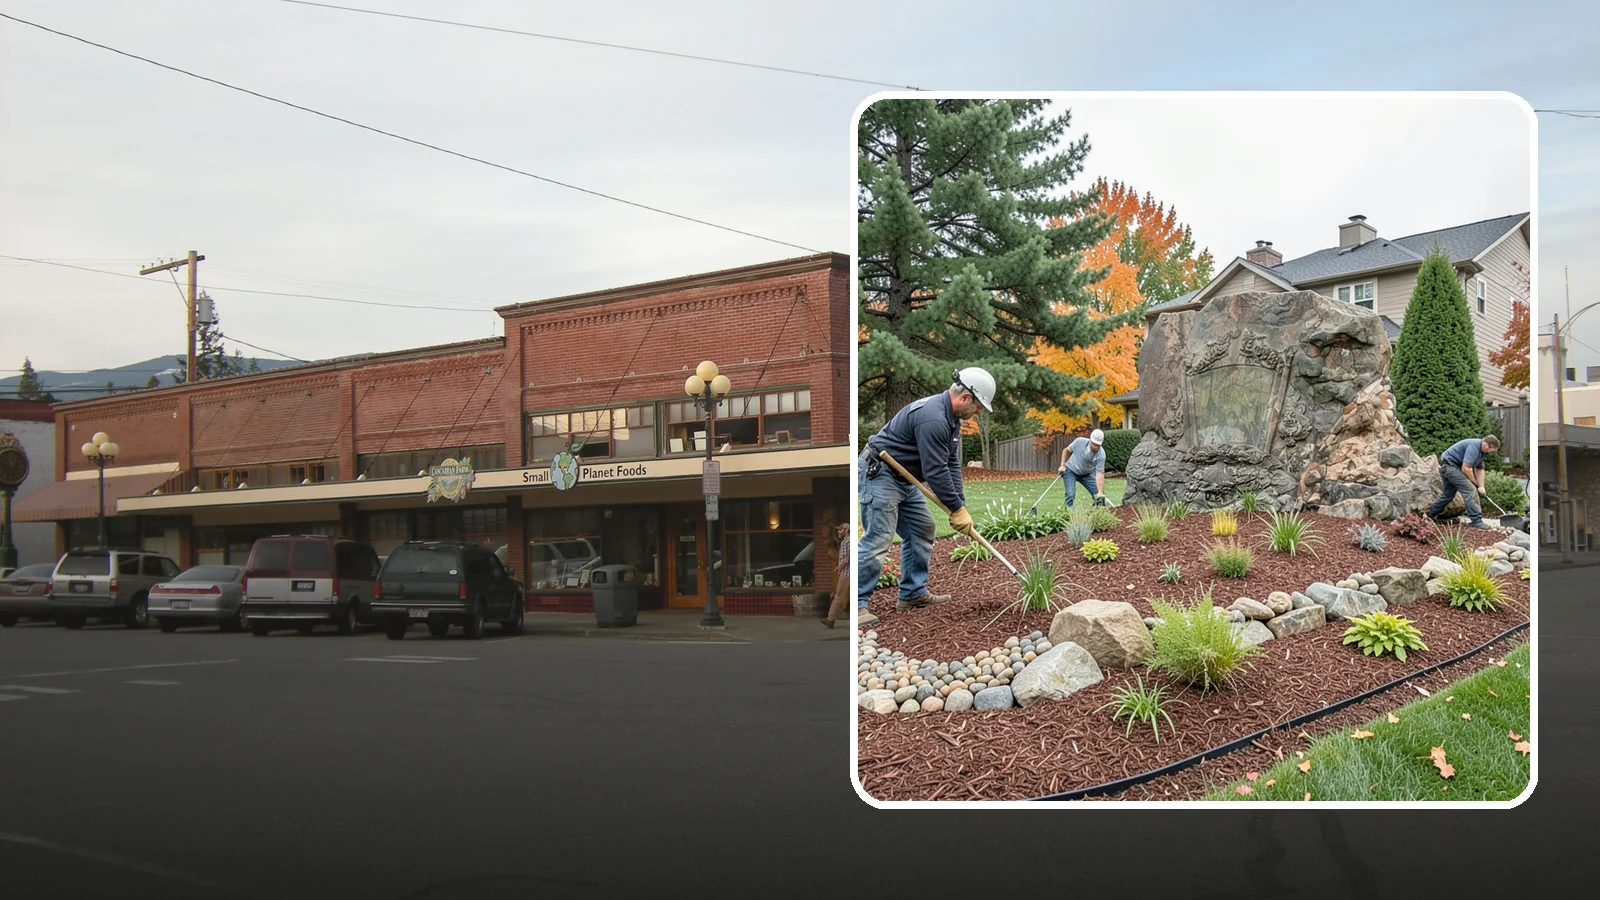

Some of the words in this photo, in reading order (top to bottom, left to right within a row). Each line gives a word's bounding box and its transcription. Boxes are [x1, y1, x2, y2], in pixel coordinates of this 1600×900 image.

[523, 471, 549, 483] Small
[582, 467, 614, 479] Planet
[616, 464, 647, 477] Foods
